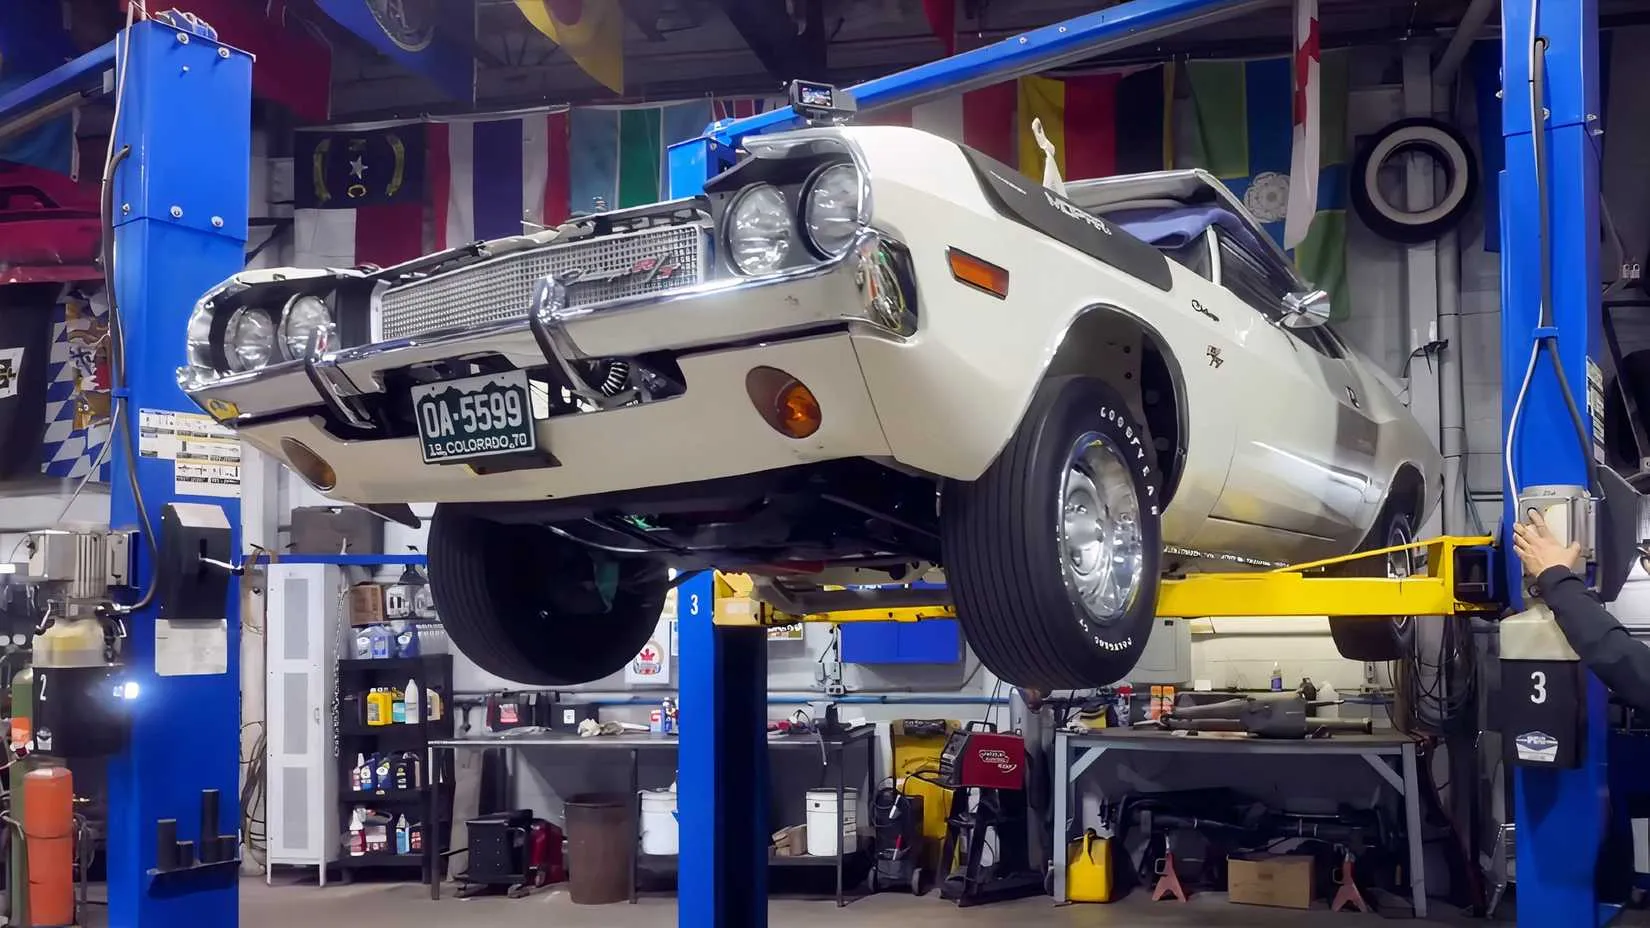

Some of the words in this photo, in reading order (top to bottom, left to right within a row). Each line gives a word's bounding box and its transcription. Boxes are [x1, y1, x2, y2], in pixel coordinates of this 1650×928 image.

[446, 435, 508, 453] COLORADO
[690, 594, 699, 616] 3
[40, 674, 47, 701] 2
[1531, 671, 1546, 703] 3
